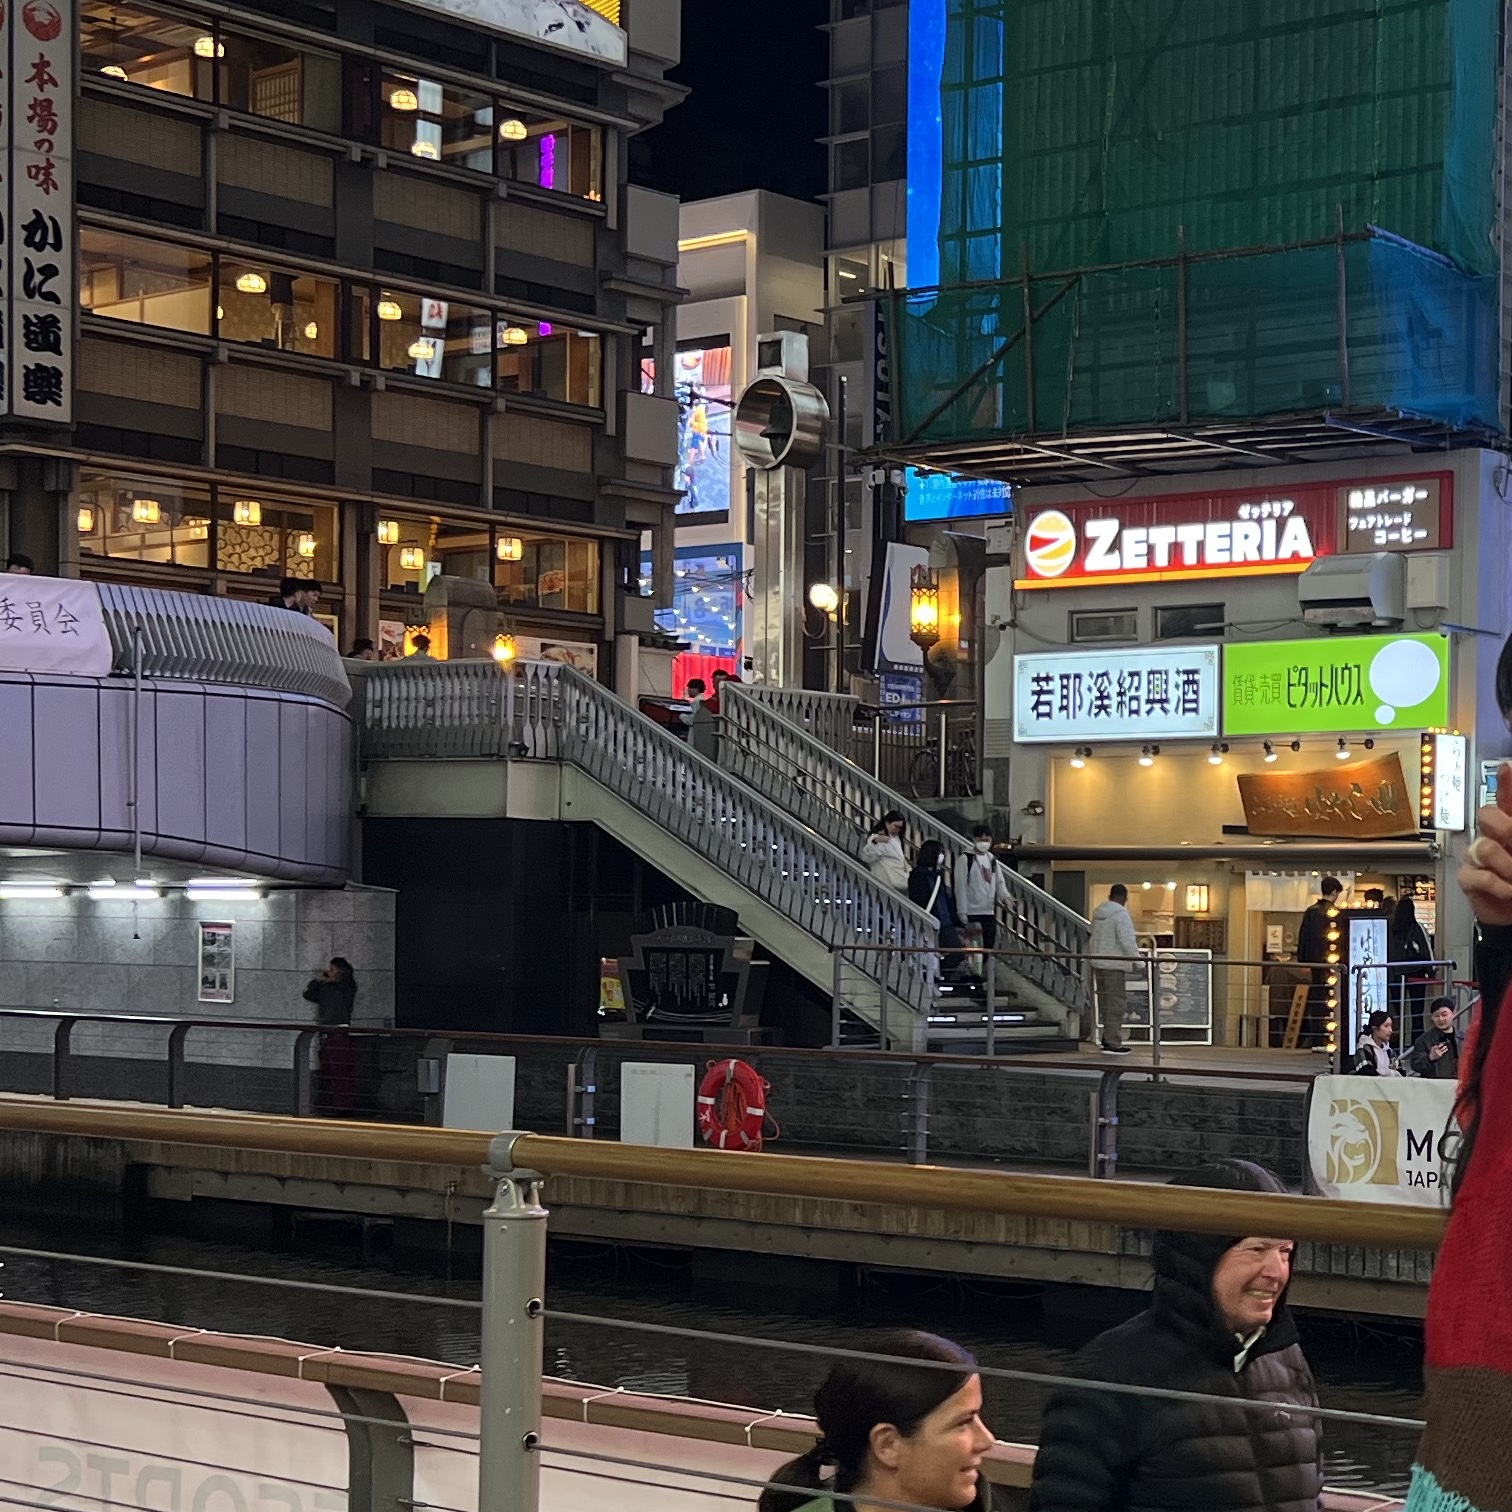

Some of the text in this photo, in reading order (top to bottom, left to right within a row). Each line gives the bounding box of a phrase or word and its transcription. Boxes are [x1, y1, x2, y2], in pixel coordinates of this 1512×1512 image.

[24, 52, 59, 196] 本場の味
[1237, 500, 1296, 520] ゼッテリア
[1083, 514, 1314, 572] ZETTERIA
[1374, 526, 1428, 545] コーヒー
[0, 596, 80, 636] 委員会
